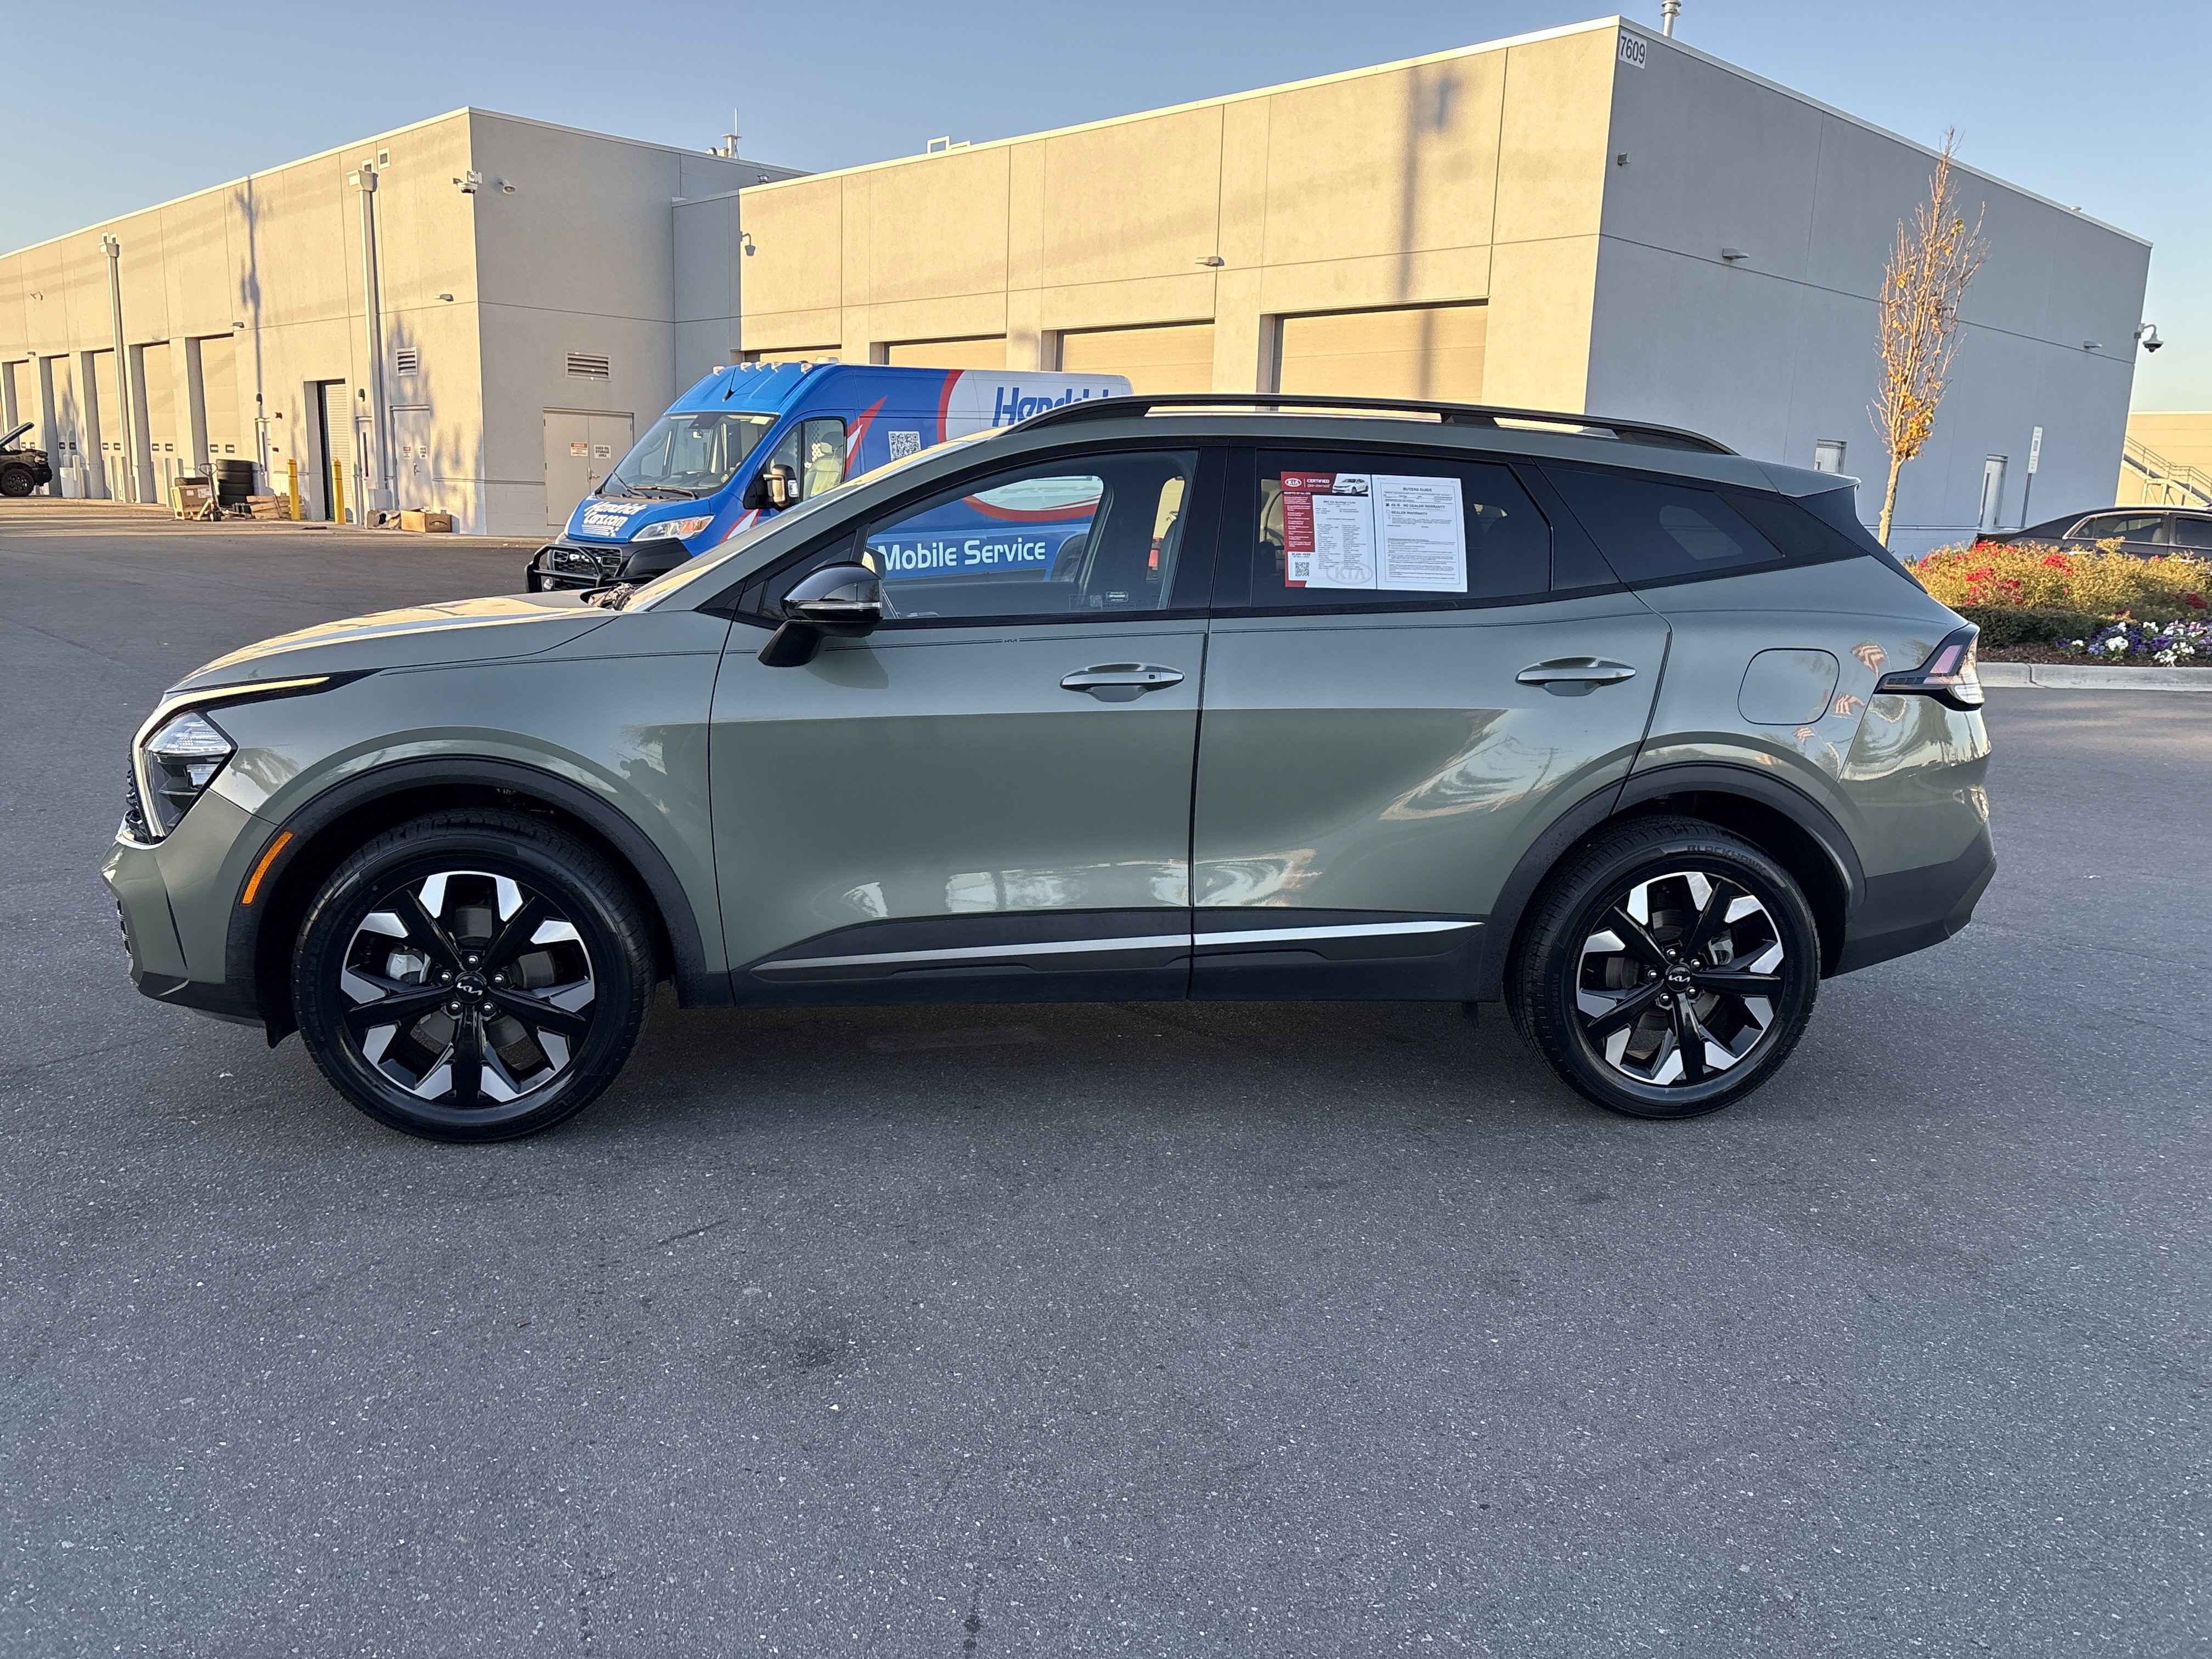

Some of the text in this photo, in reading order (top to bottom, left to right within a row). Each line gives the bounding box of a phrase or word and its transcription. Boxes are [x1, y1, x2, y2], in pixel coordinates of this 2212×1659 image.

[1621, 36, 1645, 64] 7609
[583, 511, 629, 527] Cars.com
[878, 538, 1046, 571] Mobile Service
[1335, 566, 1367, 580] KIA
[1687, 844, 1767, 874] BLACKHAWK
